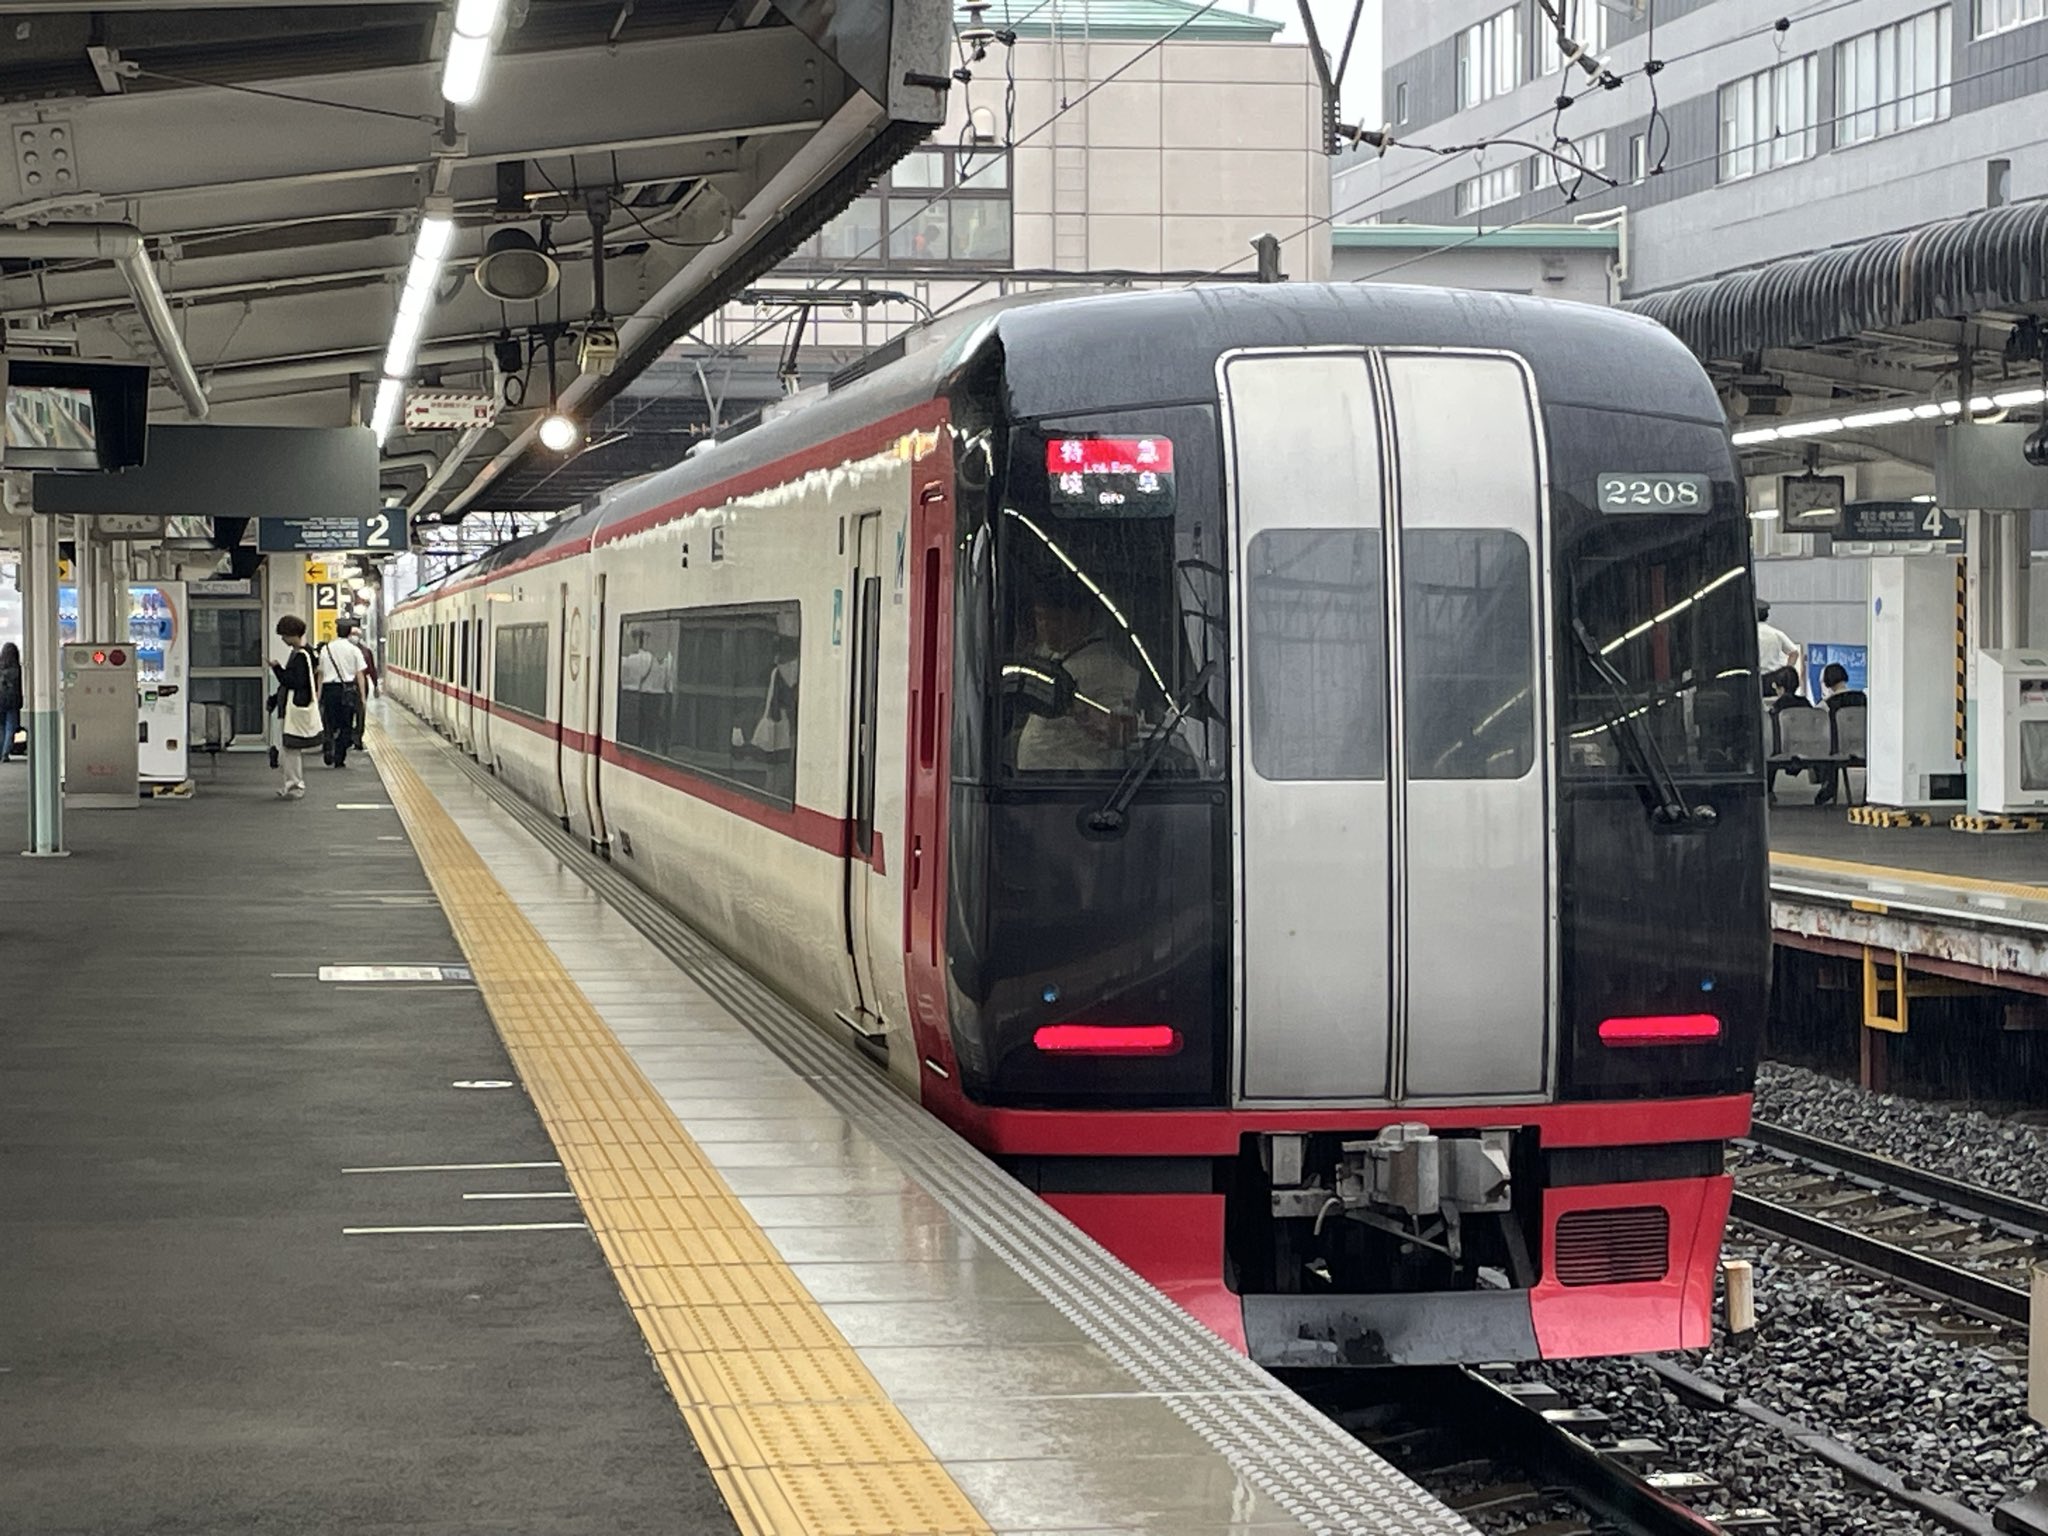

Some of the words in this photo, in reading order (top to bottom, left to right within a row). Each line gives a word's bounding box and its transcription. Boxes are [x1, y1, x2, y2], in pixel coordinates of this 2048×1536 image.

[1060, 470, 1160, 494] 岐阜
[1605, 481, 1699, 505] 2208
[366, 514, 390, 547] 2
[1922, 506, 1944, 537] 4
[319, 586, 336, 606] 2
